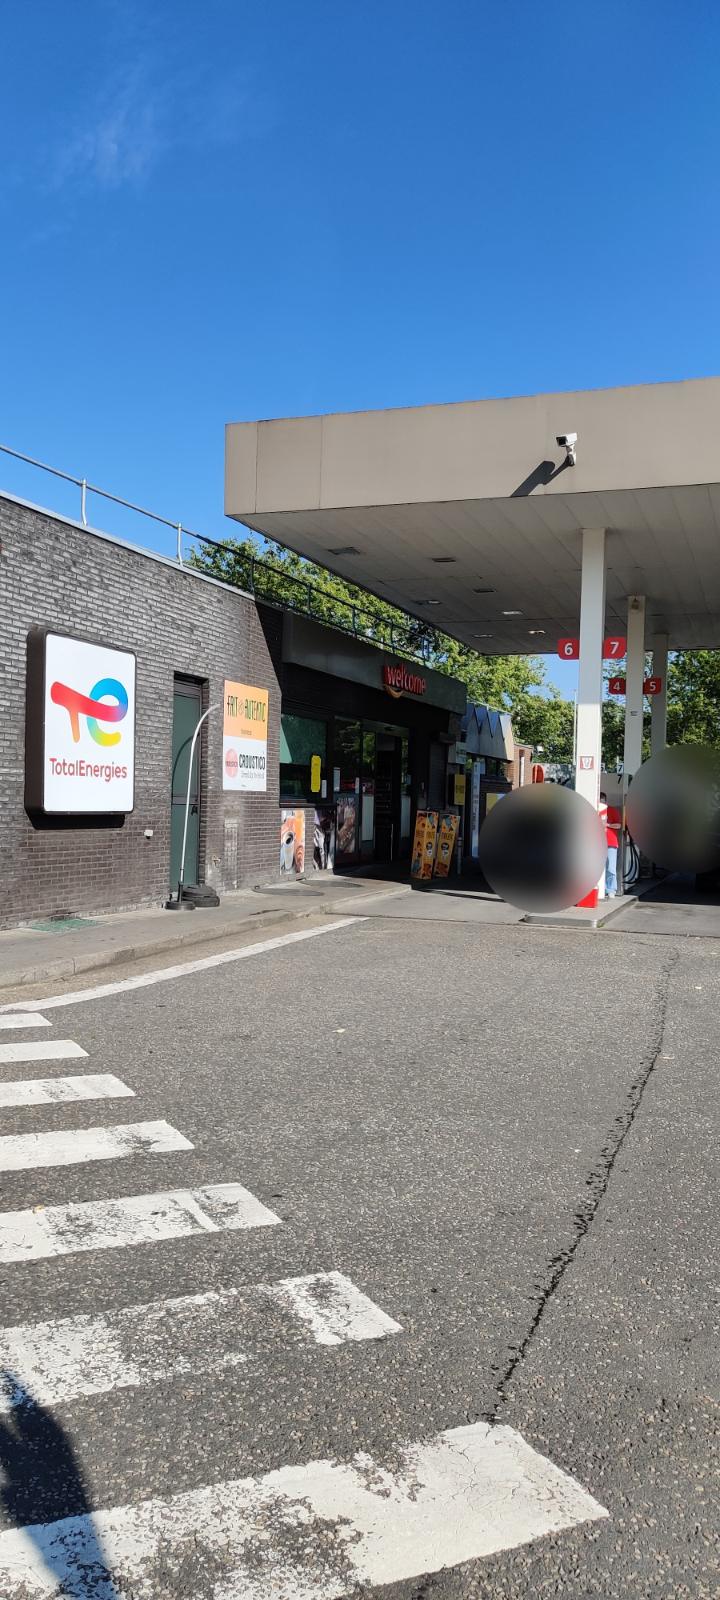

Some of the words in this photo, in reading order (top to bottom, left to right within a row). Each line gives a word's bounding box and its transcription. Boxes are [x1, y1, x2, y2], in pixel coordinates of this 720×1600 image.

[564, 642, 574, 656] 6
[610, 641, 619, 654] 7
[385, 662, 427, 695] welcome
[613, 682, 621, 691] 4
[649, 681, 657, 691] 5
[49, 757, 128, 782] TotalEnergies
